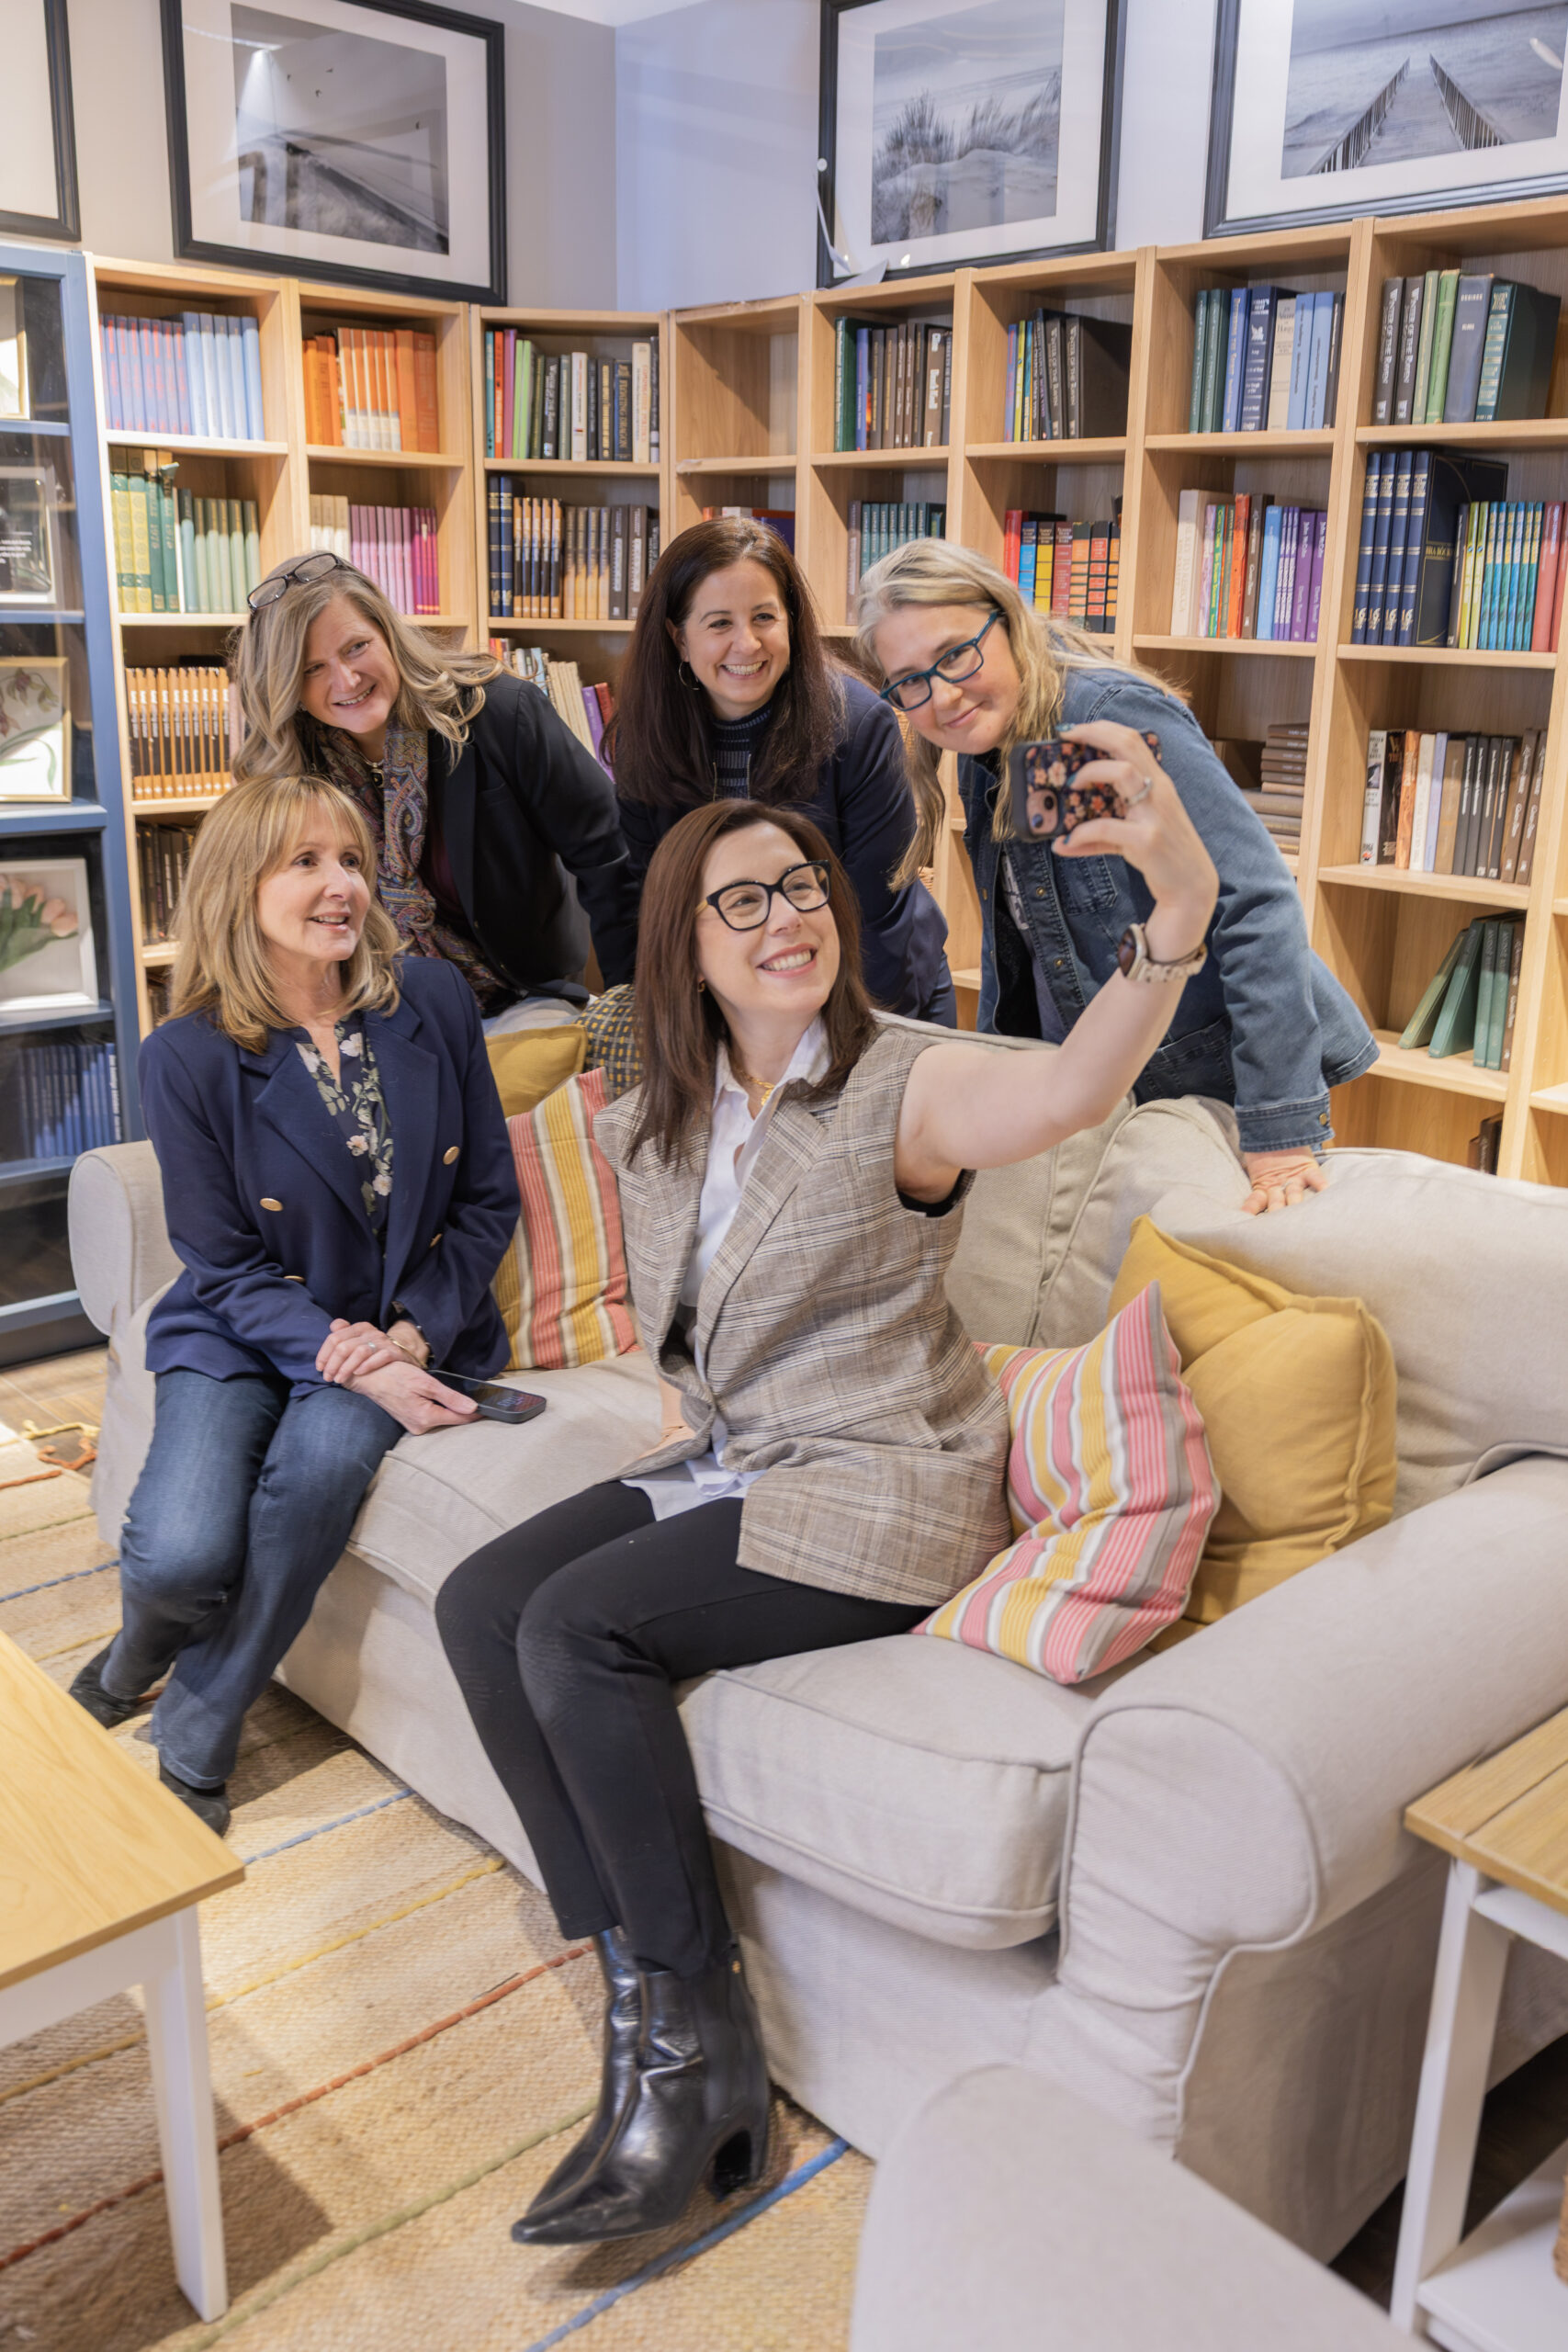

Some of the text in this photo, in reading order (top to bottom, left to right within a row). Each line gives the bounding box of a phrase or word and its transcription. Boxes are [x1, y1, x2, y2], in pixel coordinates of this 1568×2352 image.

[1387, 288, 1397, 323] WINTER
[1407, 287, 1419, 323] WINTER
[1385, 324, 1393, 337] OF
[1407, 323, 1414, 337] OF
[1051, 357, 1056, 367] OF
[1069, 357, 1075, 366] OF
[1382, 355, 1392, 383] RAVEN
[1403, 354, 1413, 383] RAVEN
[618, 379, 627, 447] FLOATING DRAGON
